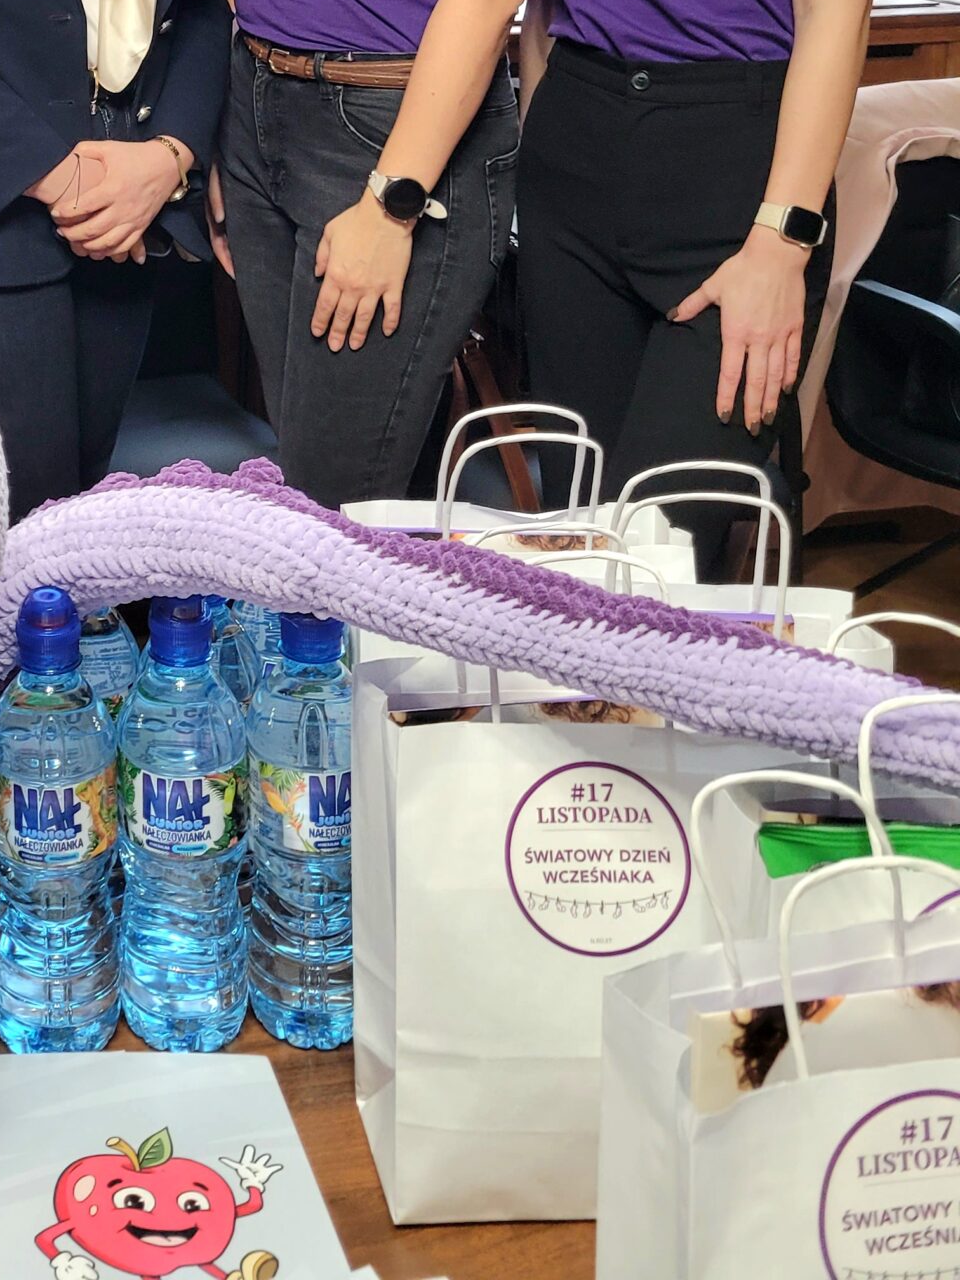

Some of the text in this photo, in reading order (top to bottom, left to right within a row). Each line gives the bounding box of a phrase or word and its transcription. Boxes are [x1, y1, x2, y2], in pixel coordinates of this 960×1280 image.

[143, 773, 210, 825] NAŁ
[309, 771, 351, 822] NA
[570, 783, 613, 802] #17
[13, 784, 81, 833] NAŁ
[537, 807, 653, 824] LISTOPADA
[147, 815, 205, 832] JUNIOR
[315, 811, 351, 827] JUNI
[19, 827, 77, 841] JUNIOR
[143, 824, 211, 842] NAŁĘCZOWIANKA
[14, 836, 84, 852] NAŁĘCZOWIANKA
[524, 847, 671, 864] ŚWIATOWY DZIEŃ
[543, 867, 654, 884] WCZEŚNIAKA
[900, 1115, 954, 1145] #17
[842, 1200, 953, 1232] ŚWIATOWY
